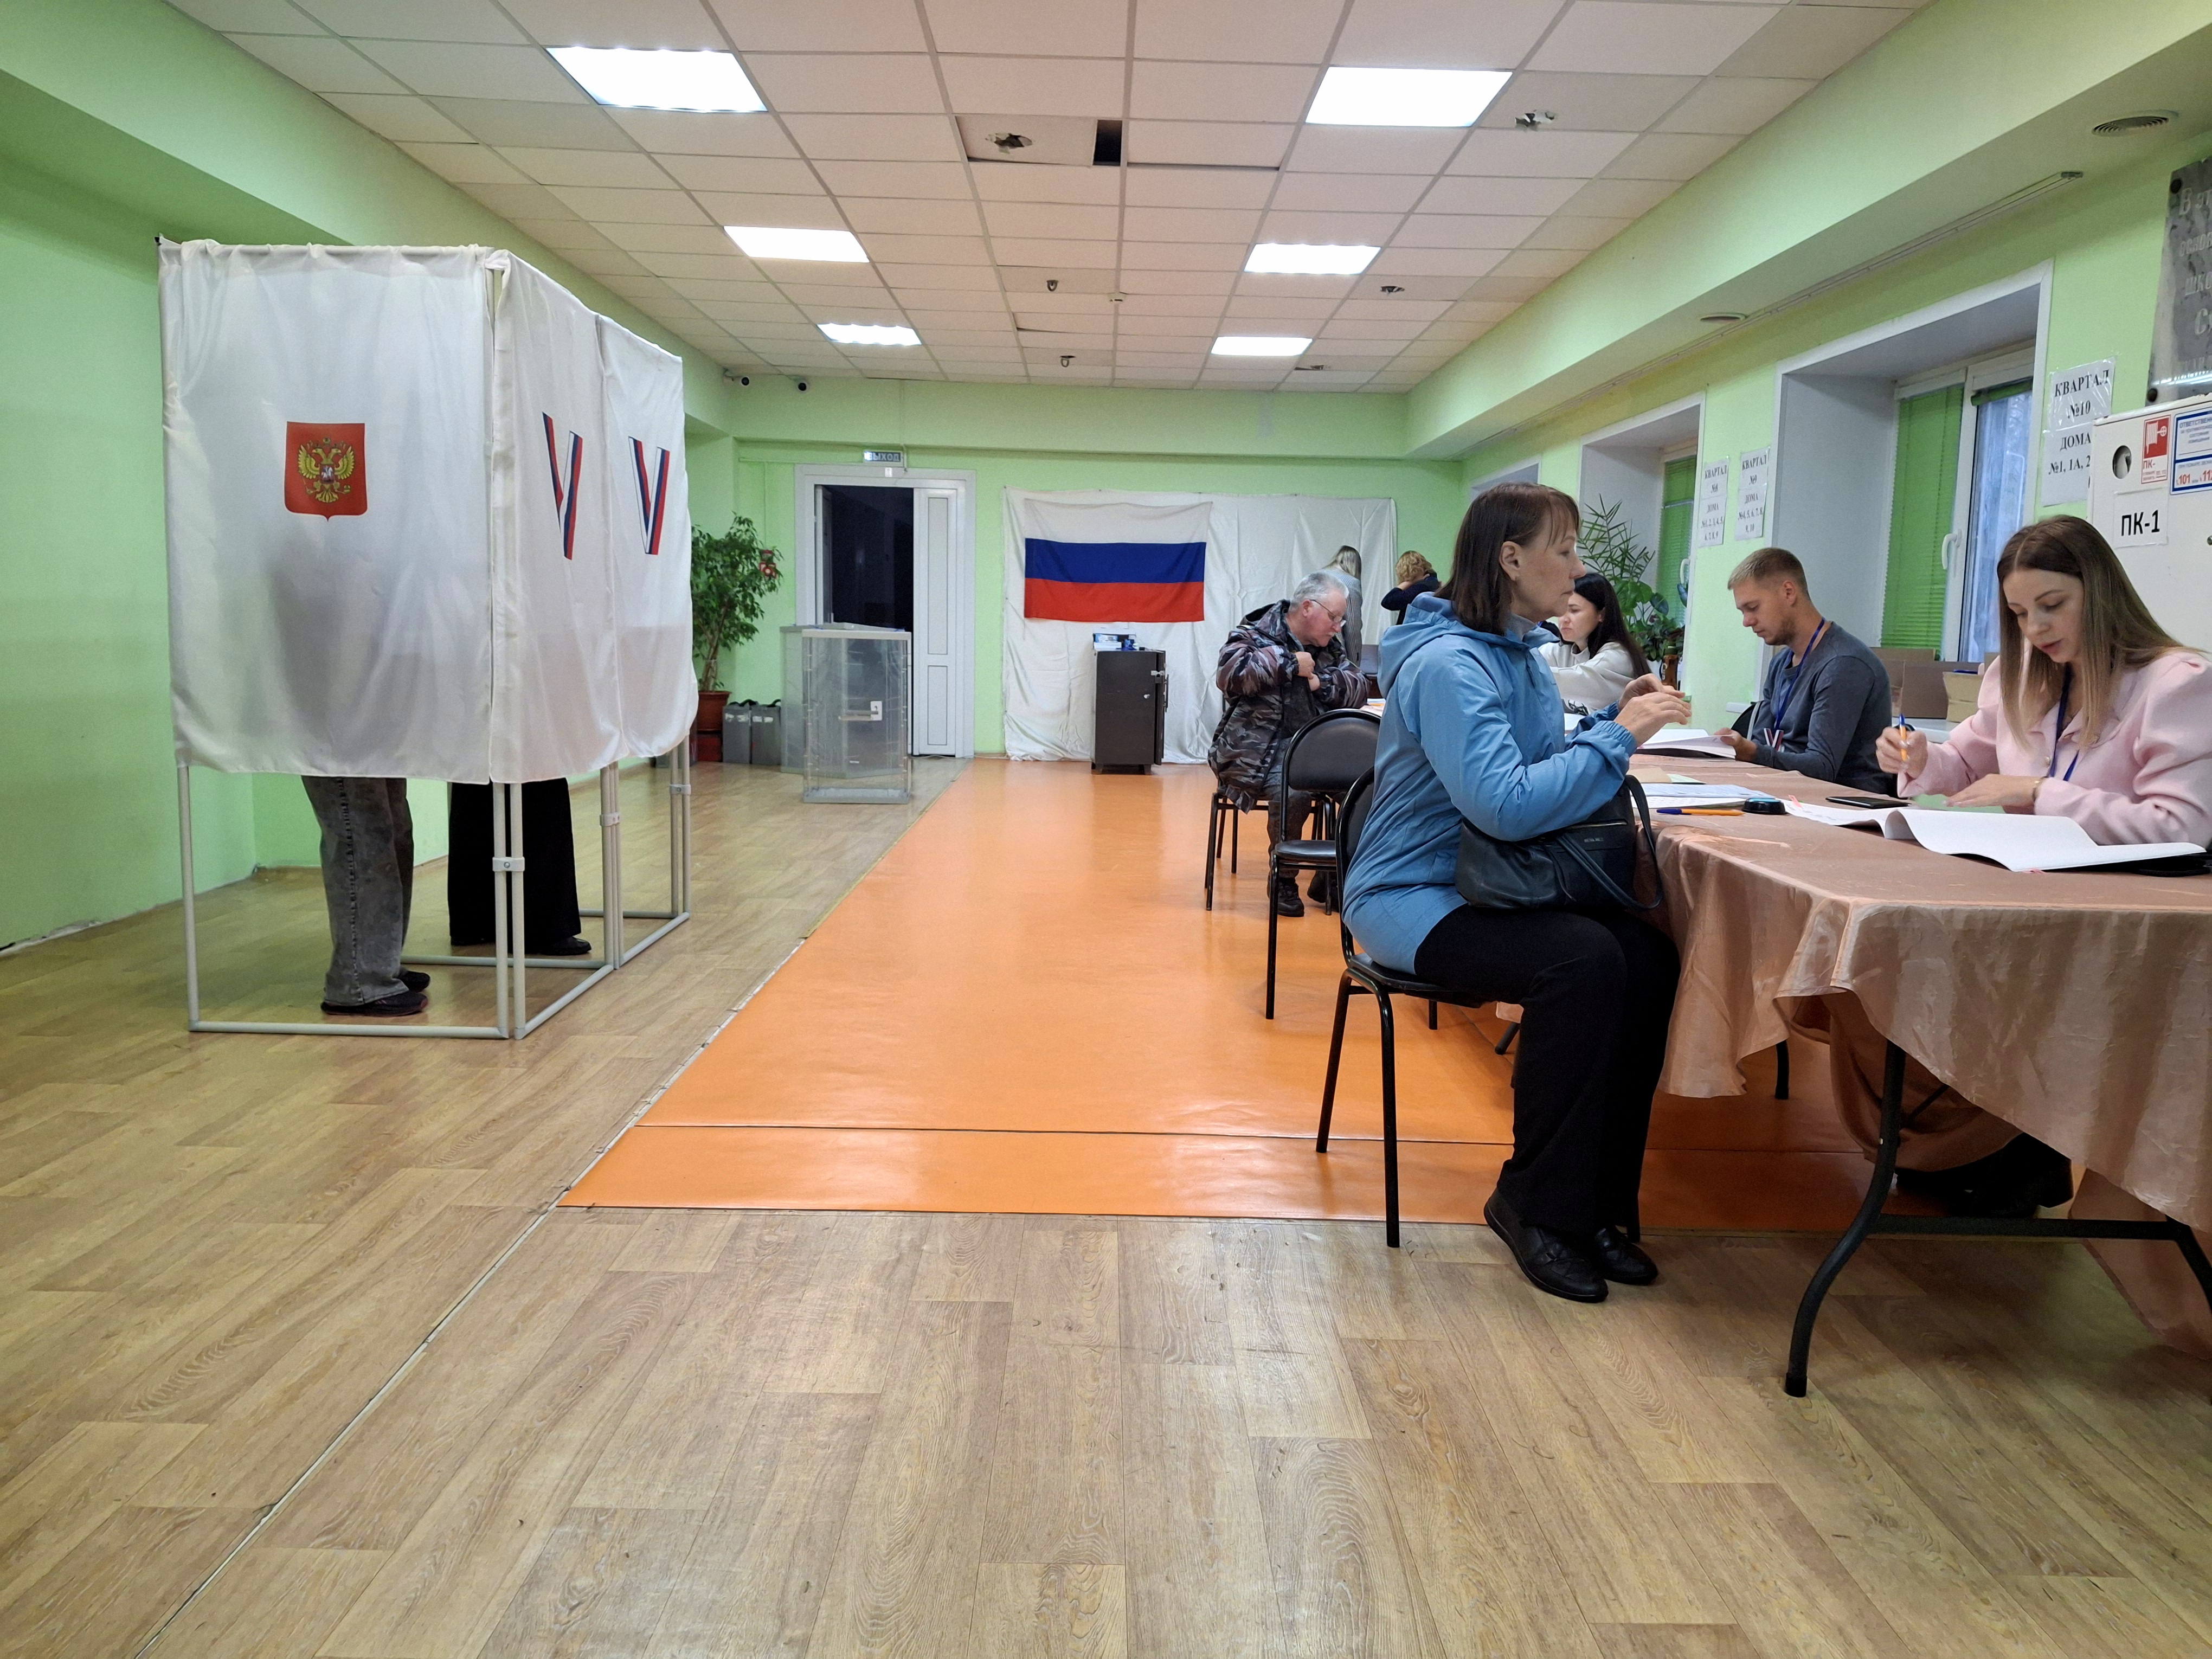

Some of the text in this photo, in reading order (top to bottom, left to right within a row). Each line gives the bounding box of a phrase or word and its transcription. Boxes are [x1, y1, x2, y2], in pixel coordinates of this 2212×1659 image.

[2054, 369, 2110, 397] КВАРТАЛ
[2067, 400, 2091, 419] №10
[2060, 432, 2091, 452] ДОМА
[1705, 465, 1727, 479] КВАРТАЛ
[1742, 454, 1766, 471] КВАРТАЛ
[2178, 473, 2191, 485] 101
[2121, 509, 2160, 536] ПК-1
